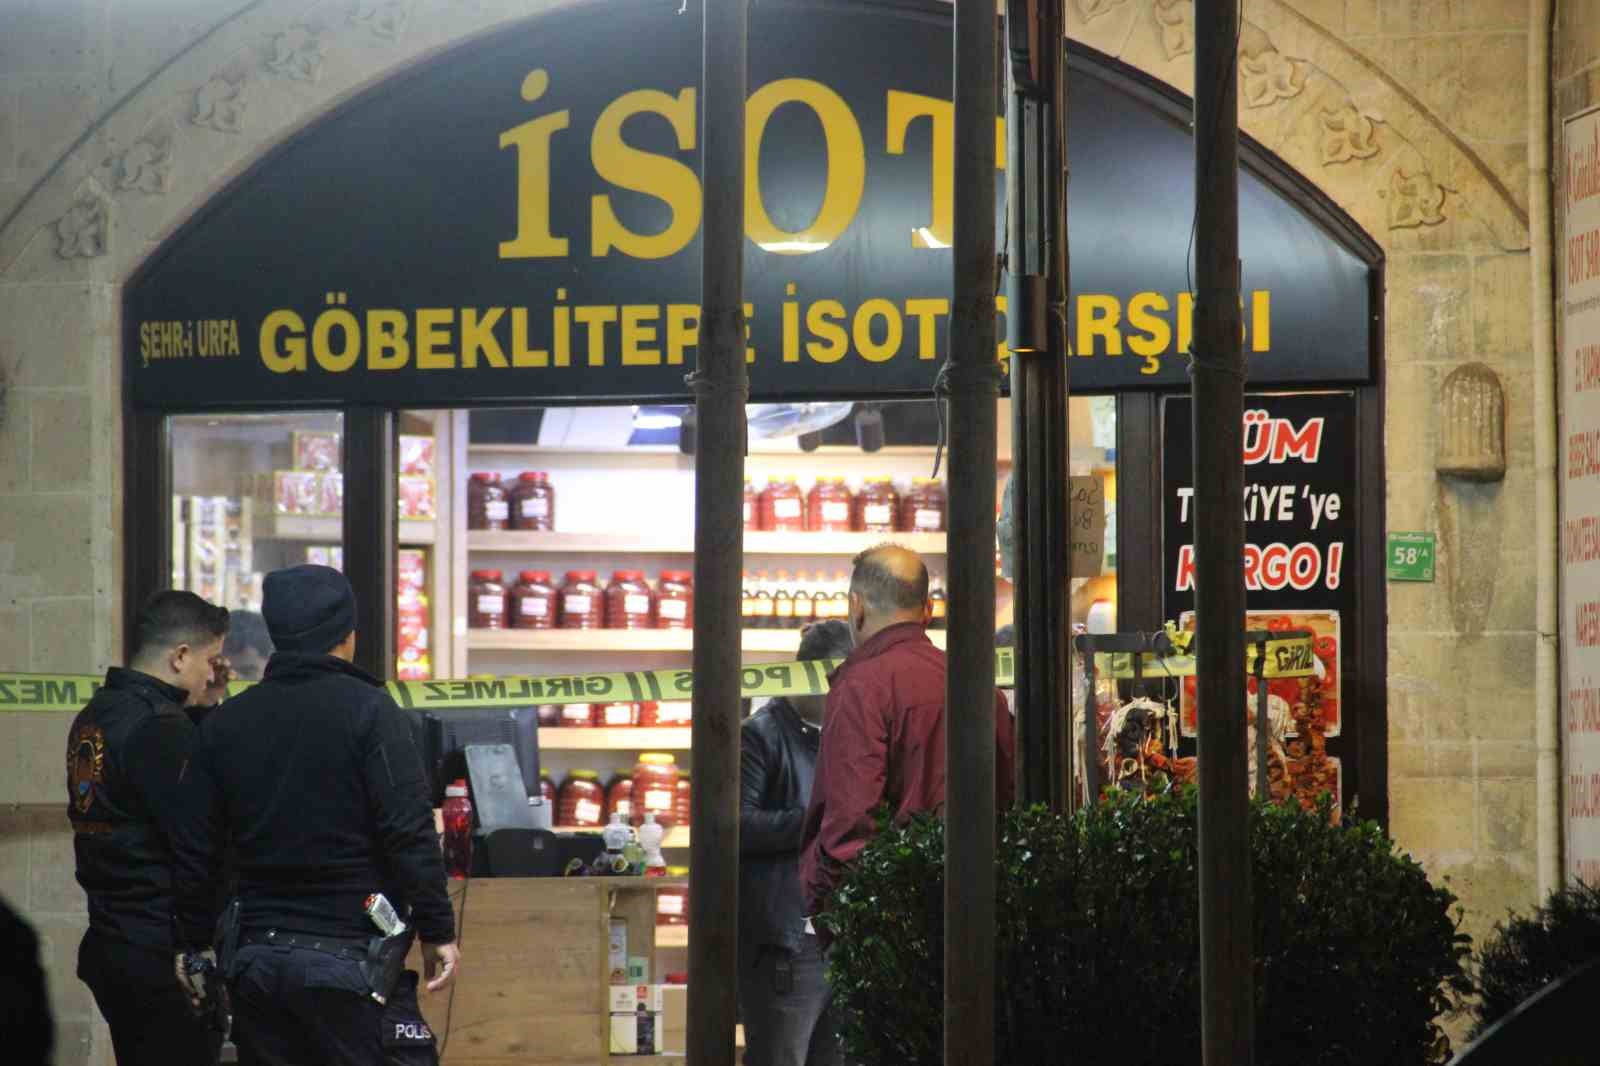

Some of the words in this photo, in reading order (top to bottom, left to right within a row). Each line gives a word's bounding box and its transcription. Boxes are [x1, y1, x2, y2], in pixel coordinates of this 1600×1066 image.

[197, 319, 240, 358] URFA
[258, 288, 755, 373] GÖBEKLİTEP
[782, 281, 949, 364] İSOT
[1243, 409, 1324, 464] ÜM
